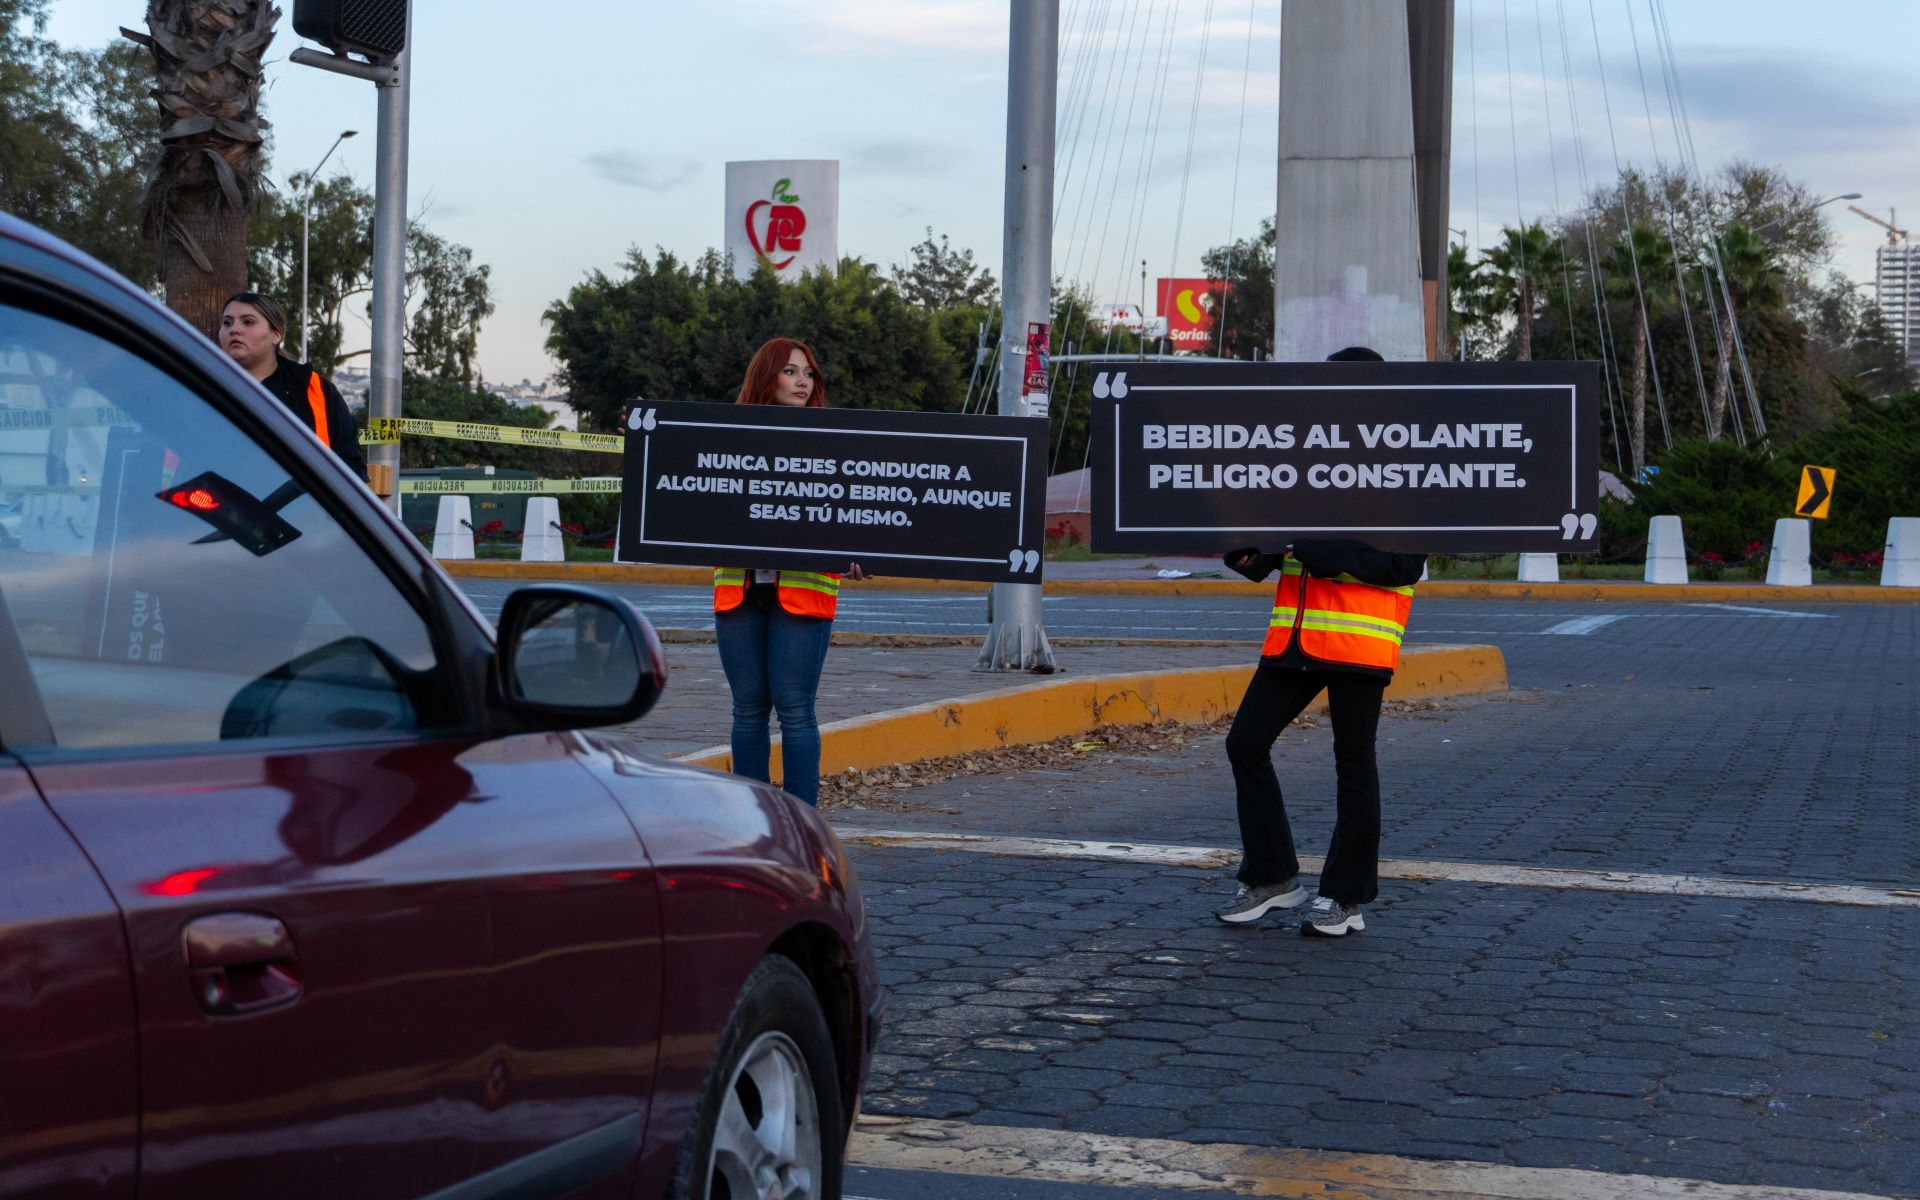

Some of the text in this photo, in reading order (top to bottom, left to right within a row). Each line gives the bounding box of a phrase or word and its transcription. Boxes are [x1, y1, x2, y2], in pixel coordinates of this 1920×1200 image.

[0, 409, 52, 427] AUCION
[1143, 423, 1533, 453] BEBIDAS AL VOLANTE,
[697, 453, 972, 481] NUNCA DEJES CONDUCIR A
[1149, 463, 1526, 489] PELIGRO CONSTANTE.
[656, 475, 1012, 510] ALGUIEN ESTANDO EBRIO, AUNQUE
[749, 503, 913, 527] SEAS TÚ MISMO.
